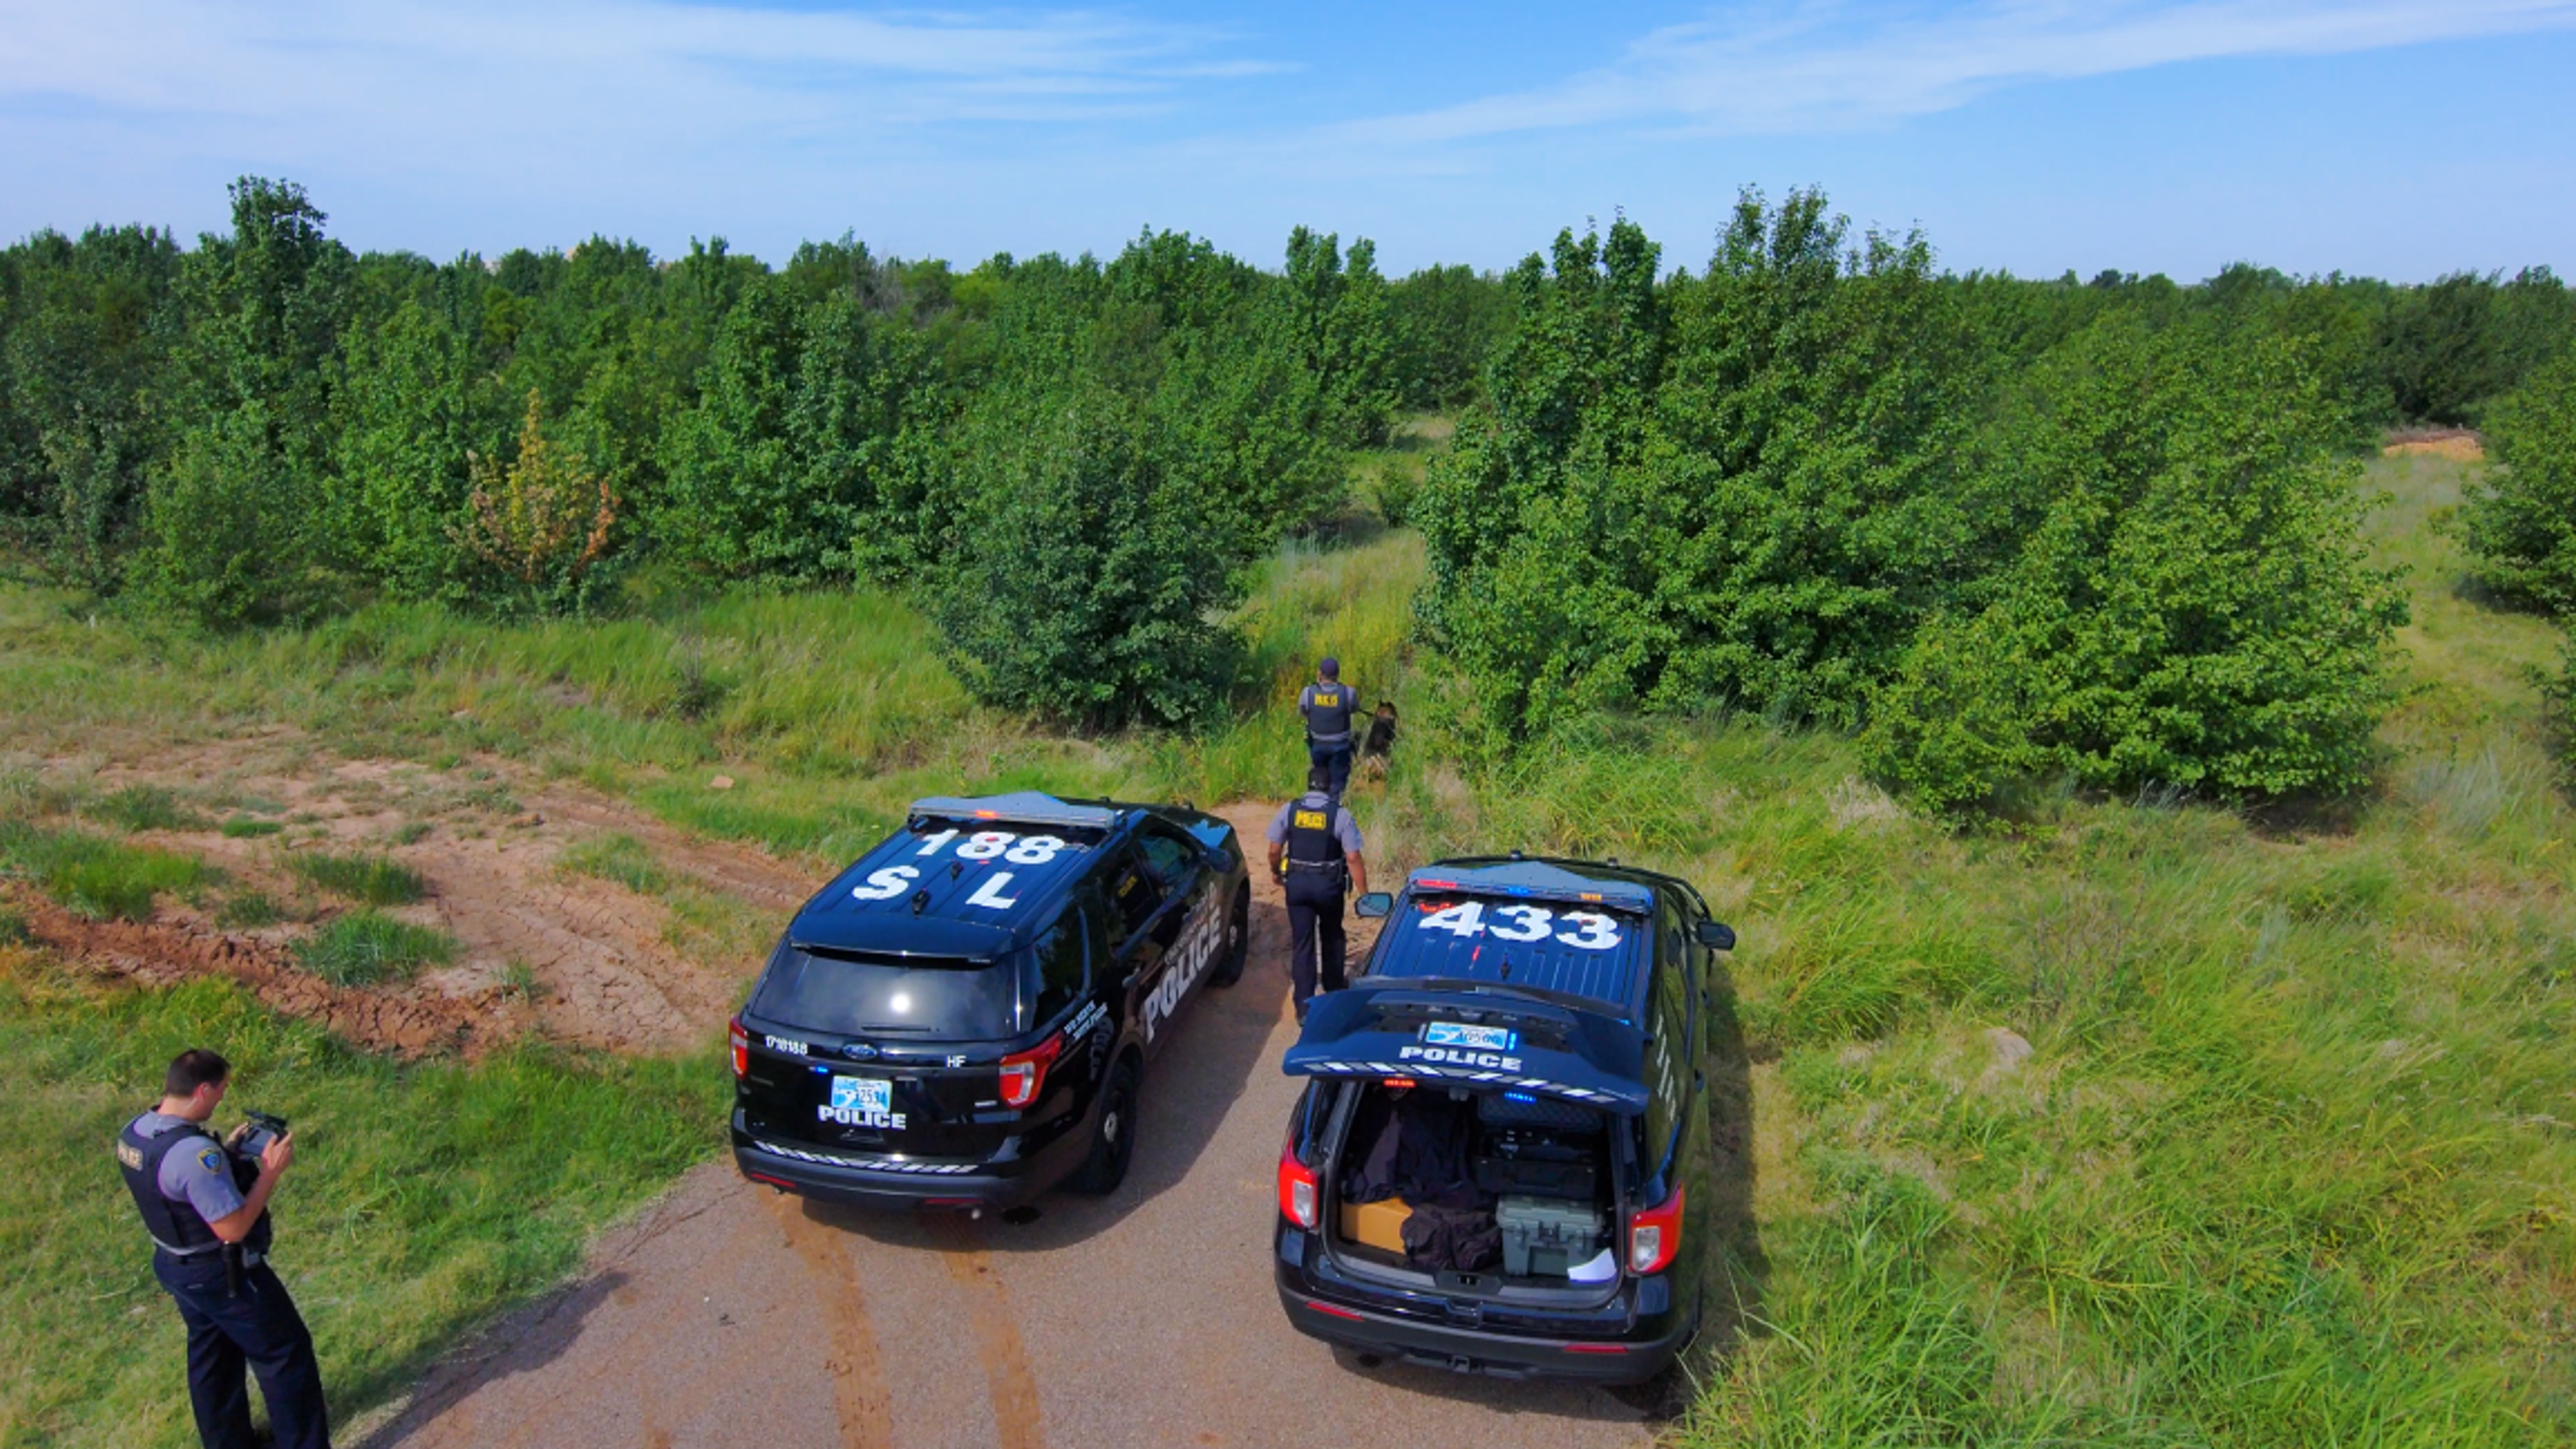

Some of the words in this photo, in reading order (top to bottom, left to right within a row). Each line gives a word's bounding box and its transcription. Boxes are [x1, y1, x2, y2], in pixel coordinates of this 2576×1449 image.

[916, 828, 1065, 864] 188
[852, 865, 920, 900] S
[965, 871, 1017, 909] L
[1419, 901, 1618, 949] 433
[1145, 904, 1221, 1044] POLICE
[947, 1055, 967, 1068] HF
[1399, 1046, 1522, 1071] POLICE
[818, 1104, 906, 1130] POLICE
